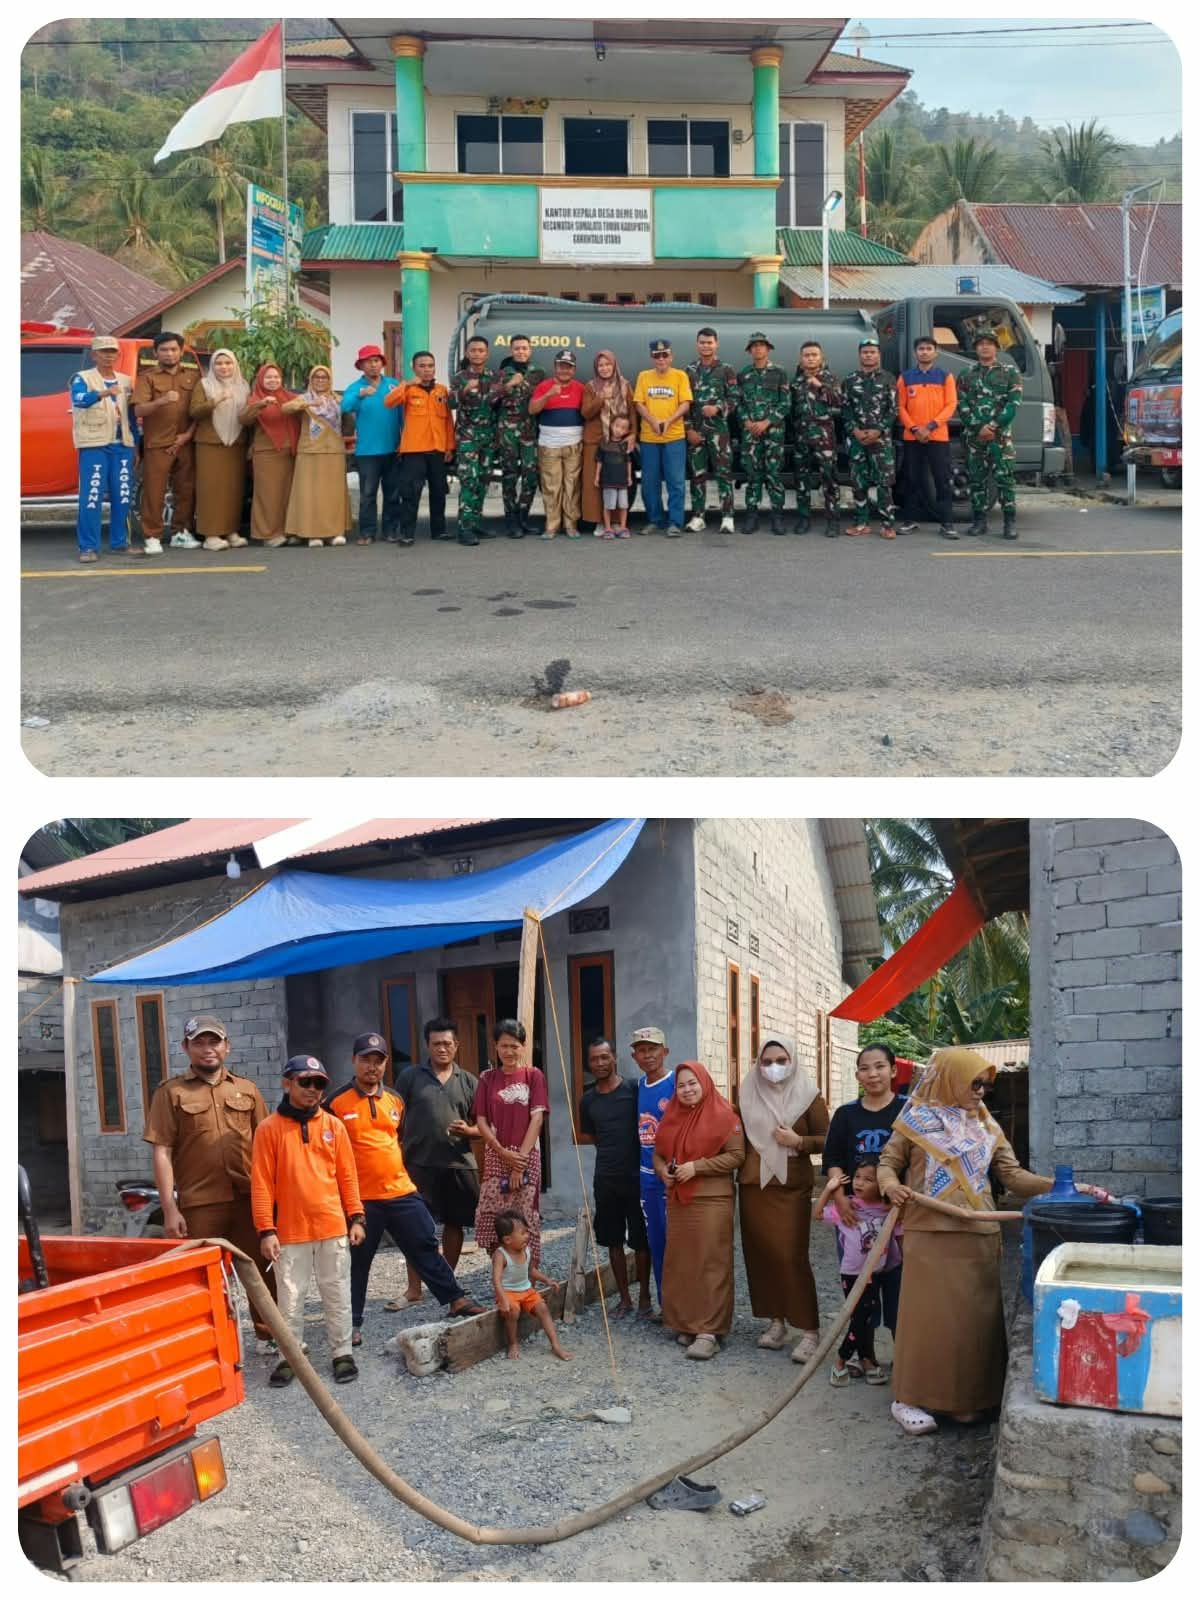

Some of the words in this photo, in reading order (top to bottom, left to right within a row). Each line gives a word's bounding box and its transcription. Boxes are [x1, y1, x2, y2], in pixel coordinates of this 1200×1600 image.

[545, 208, 572, 218] KANTOR
[573, 208, 597, 218] KEPALA
[598, 208, 615, 218] DESA
[634, 209, 648, 219] DUA
[494, 334, 513, 346] AI
[530, 335, 570, 347] 5000
[575, 336, 586, 348] L
[87, 464, 102, 509] TAGANA
[119, 459, 130, 504] TAGANA
